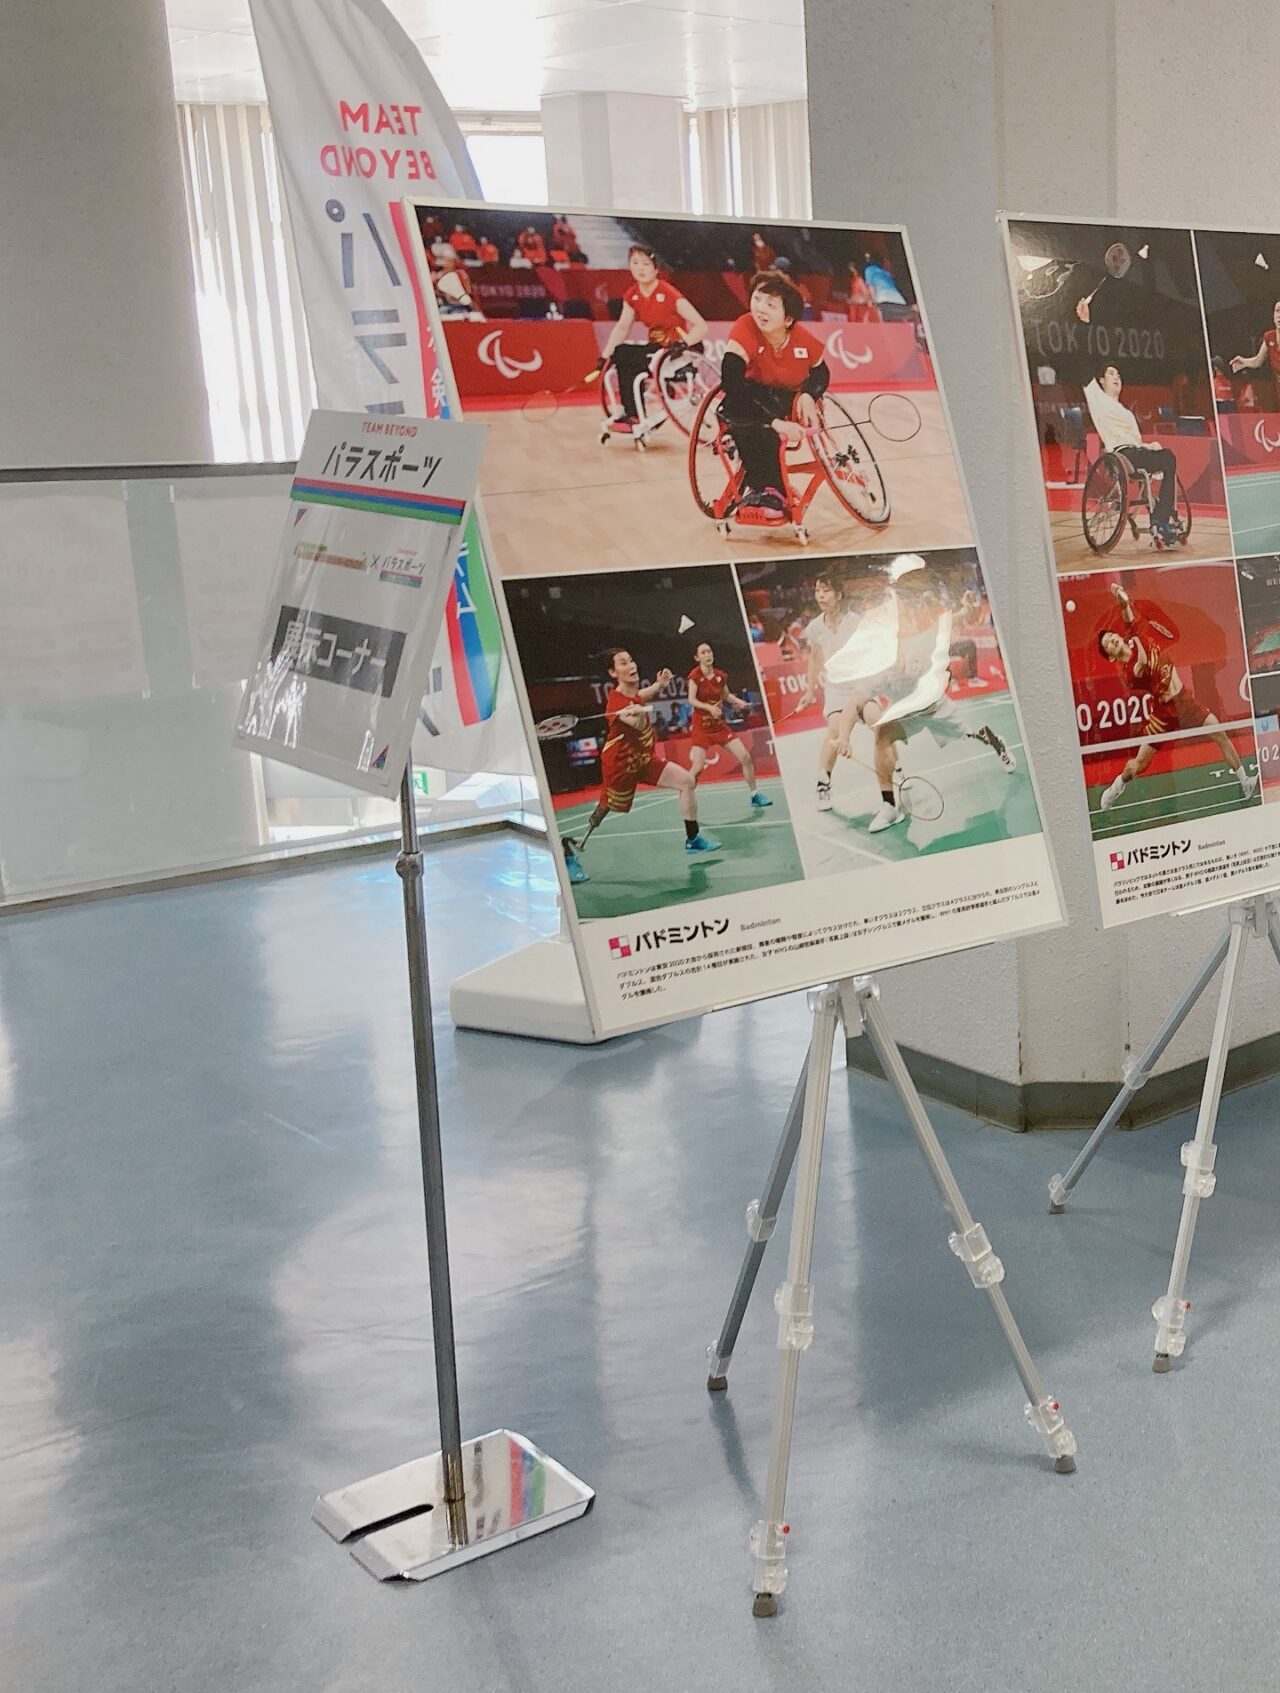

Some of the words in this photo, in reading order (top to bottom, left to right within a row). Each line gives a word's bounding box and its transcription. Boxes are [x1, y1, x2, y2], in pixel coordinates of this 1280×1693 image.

[1117, 327, 1166, 360] 2020
[362, 421, 384, 433] TEAM
[384, 425, 418, 438] BEYOND
[322, 441, 443, 488] パラスポーツ
[1127, 839, 1192, 866] バドミントン
[634, 917, 730, 952] バドミントン
[740, 917, 781, 931] Badminton
